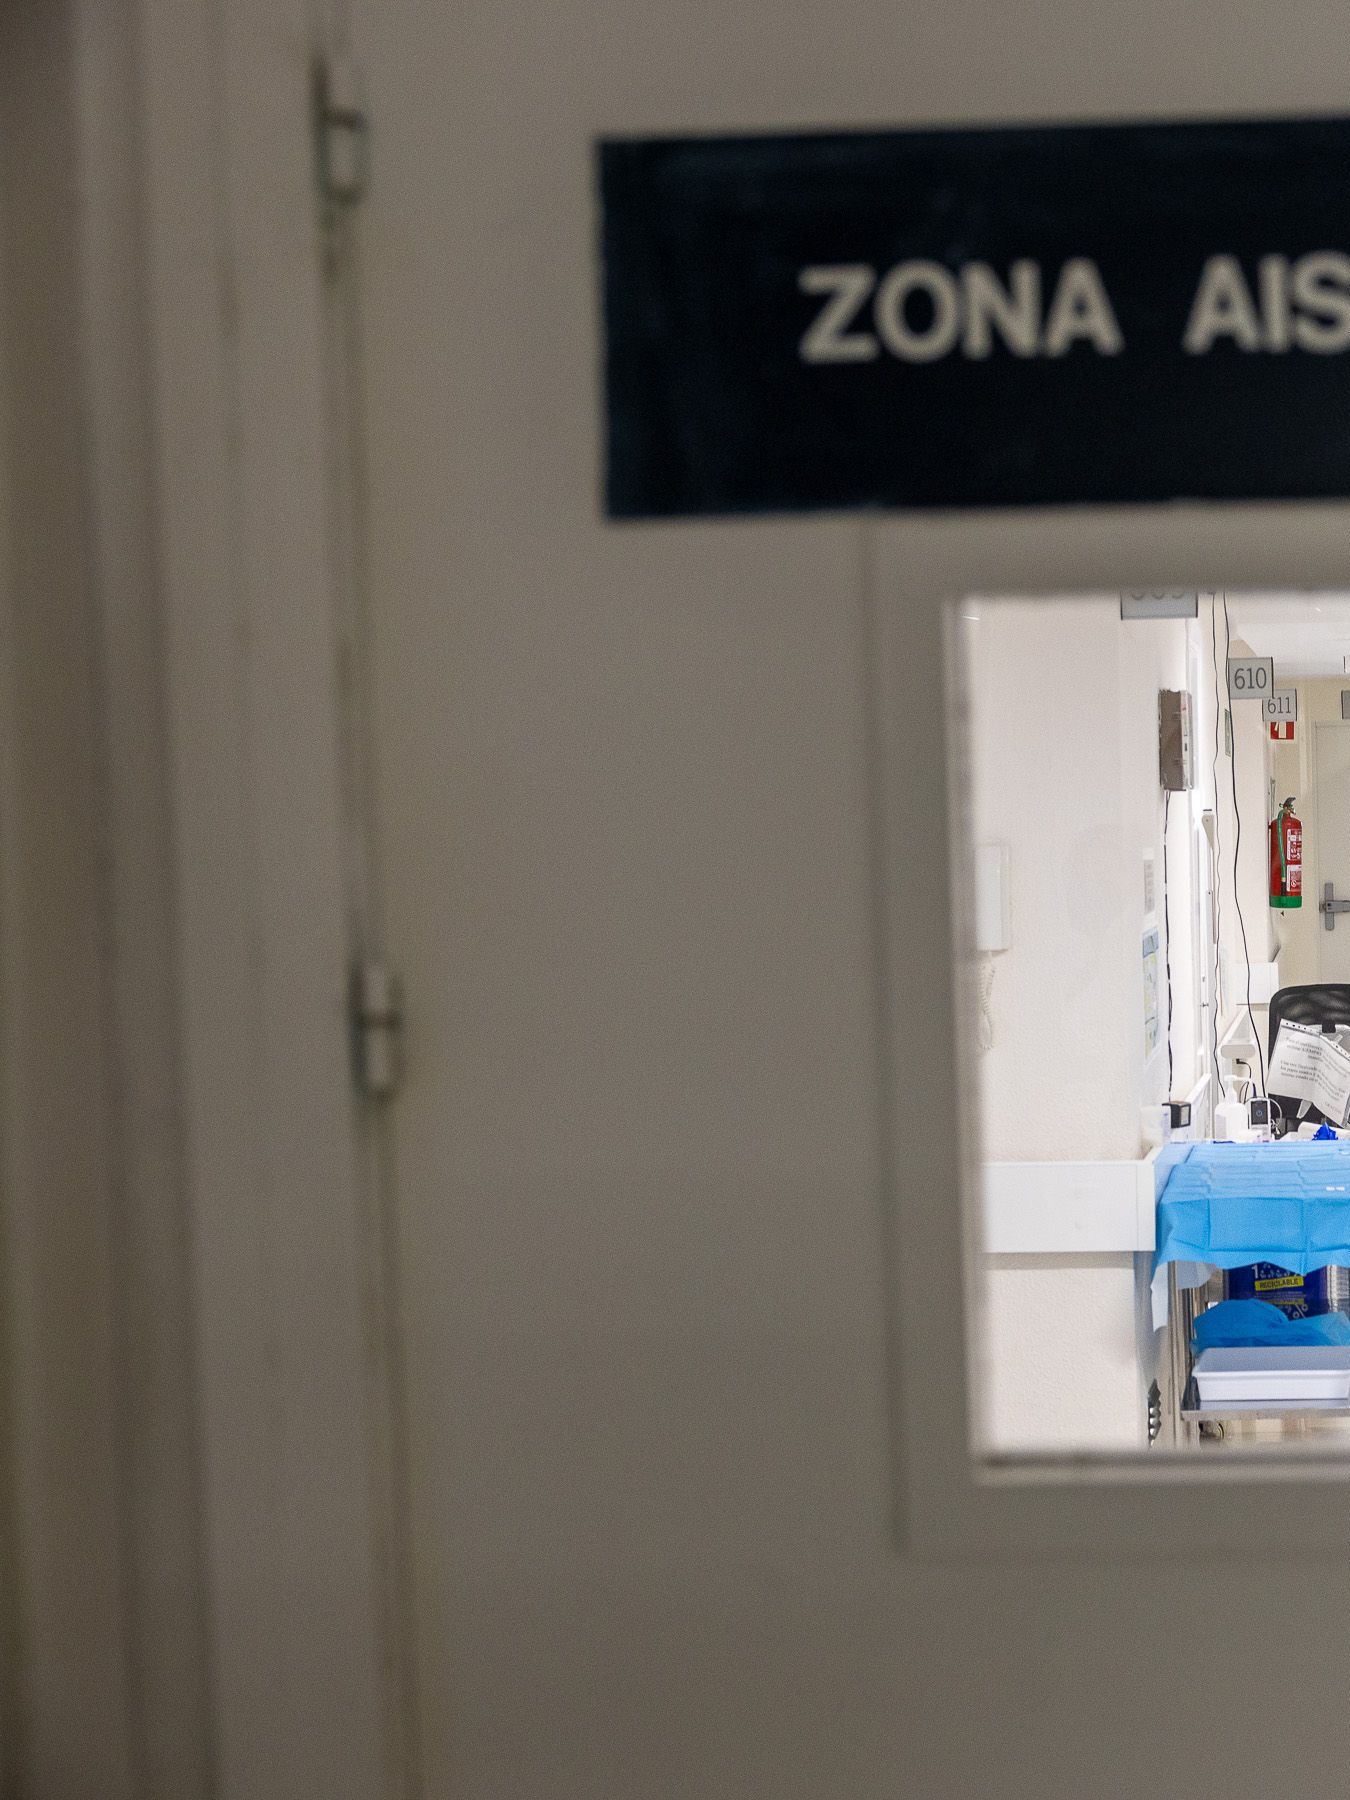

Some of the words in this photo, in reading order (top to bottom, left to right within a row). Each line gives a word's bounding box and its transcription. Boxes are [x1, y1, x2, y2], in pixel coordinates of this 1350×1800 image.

[799, 257, 1125, 362] ZONA
[1234, 667, 1267, 690] 610
[1267, 696, 1292, 714] 611
